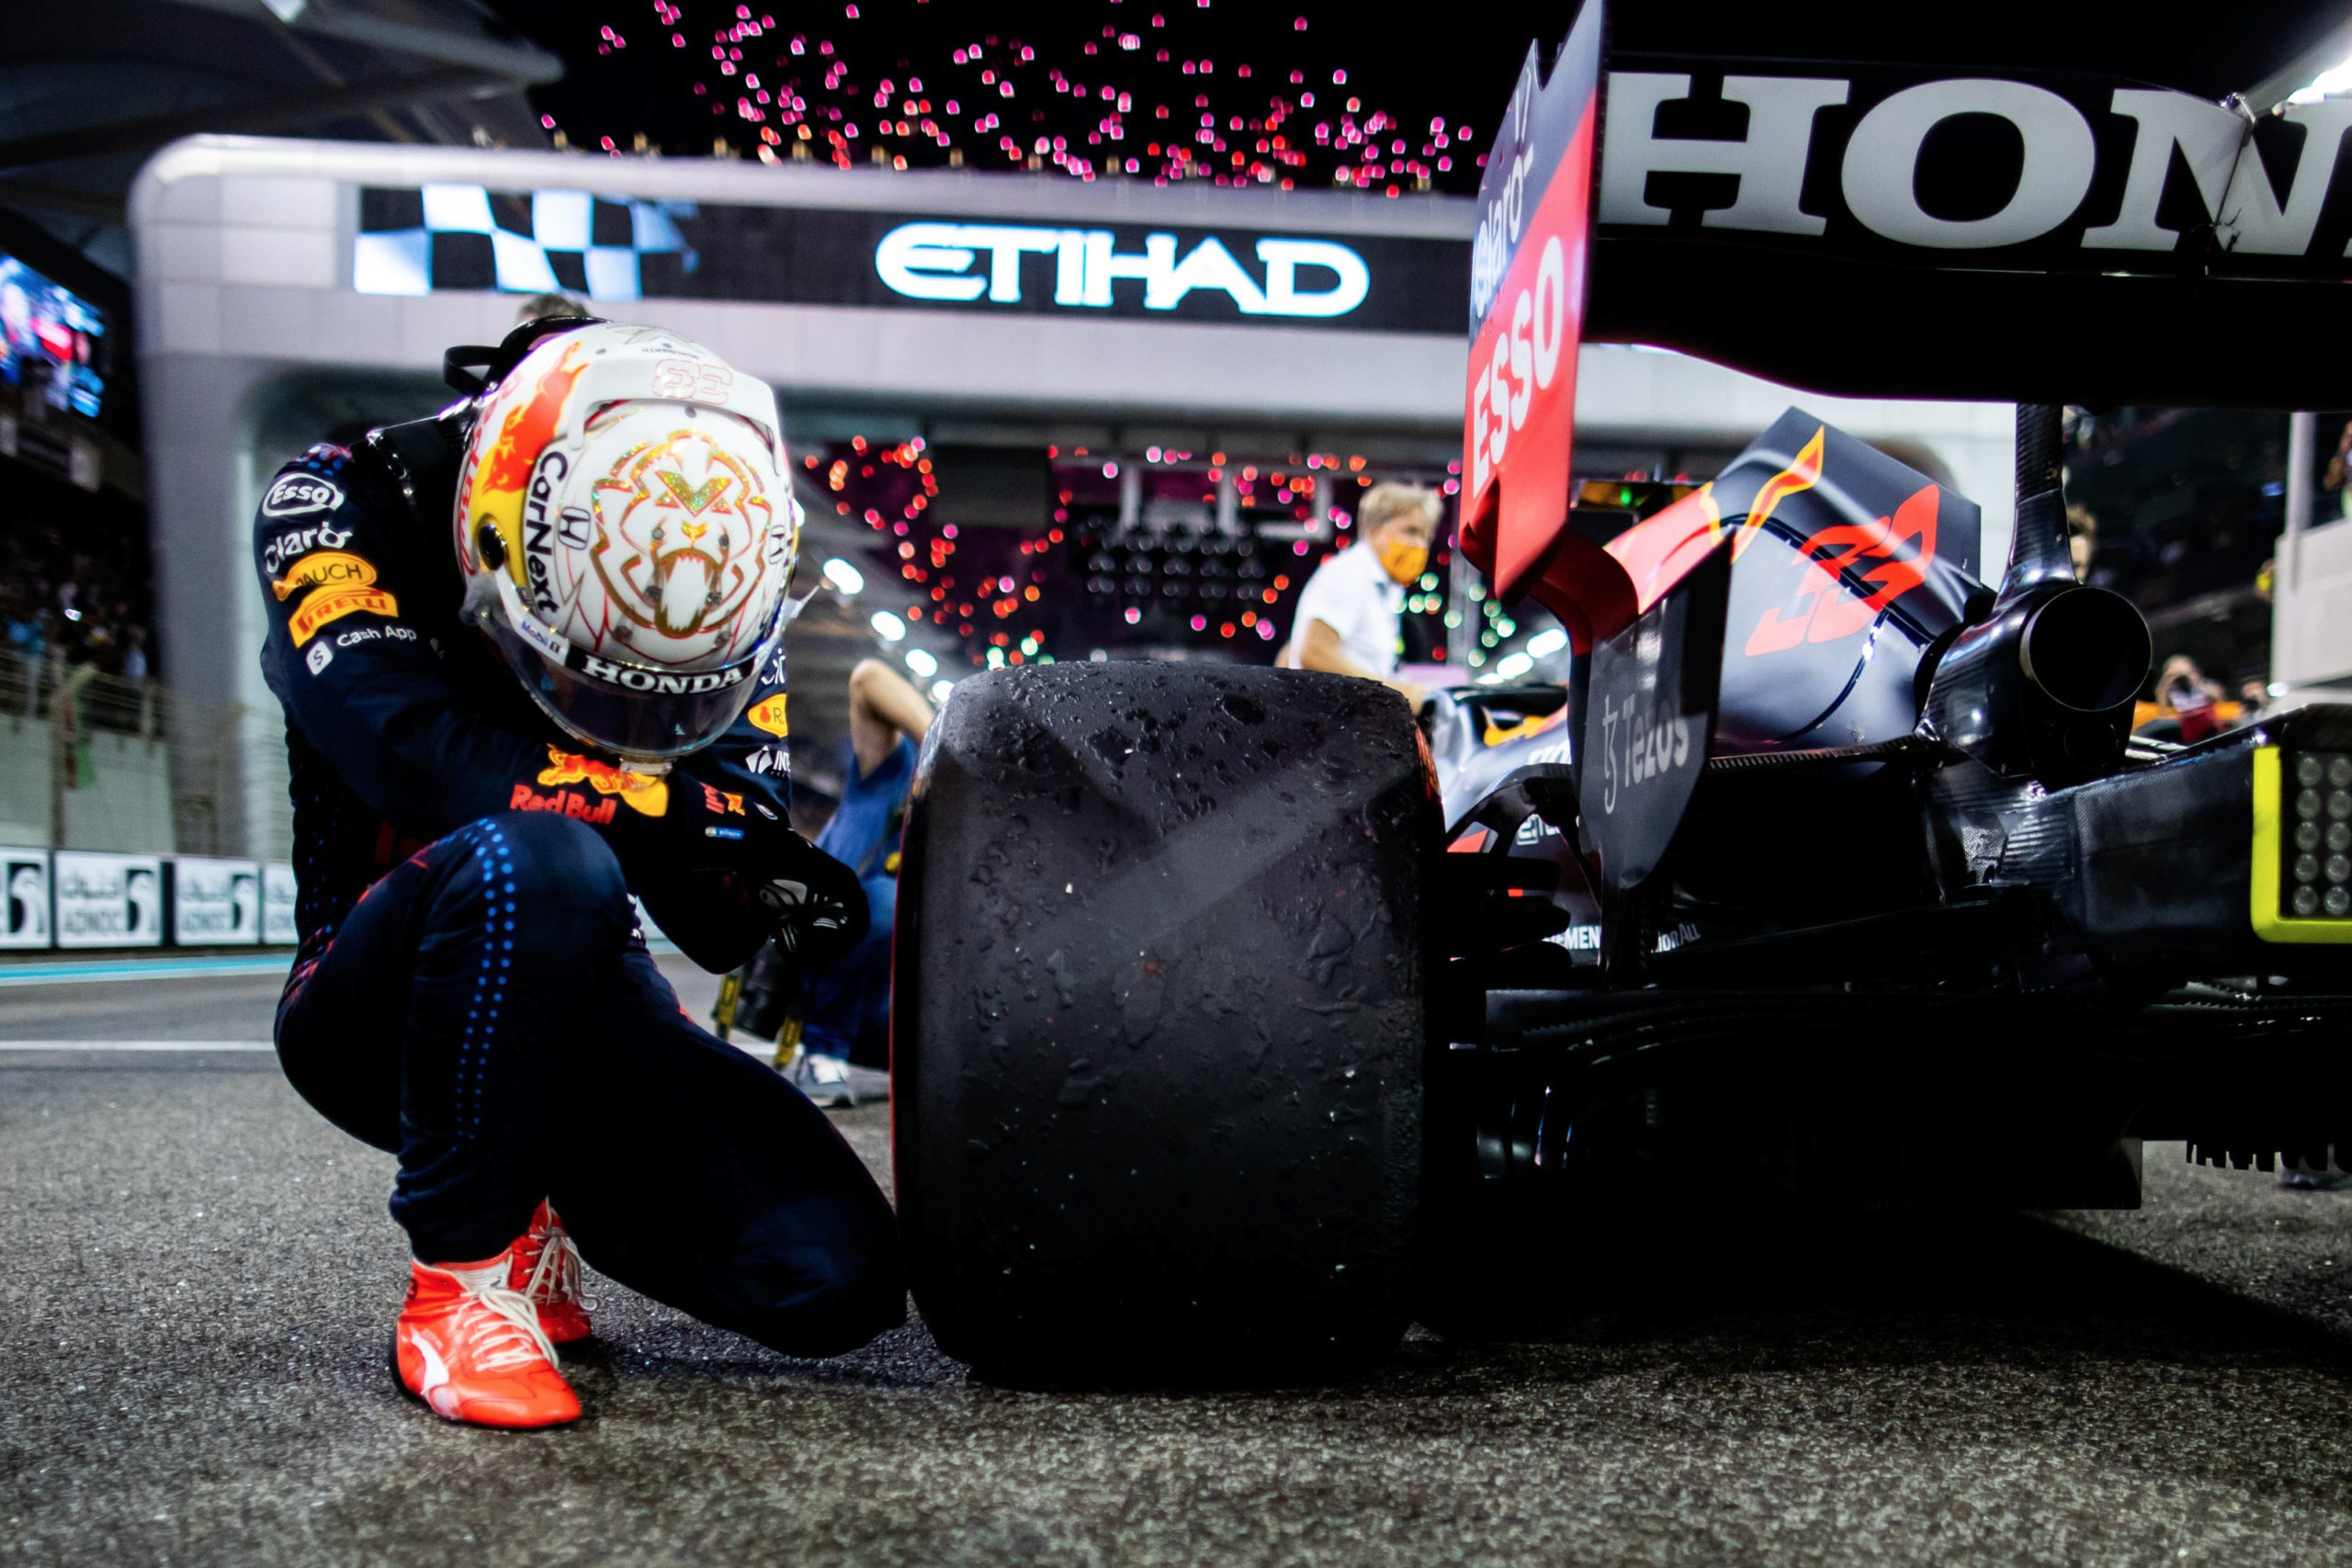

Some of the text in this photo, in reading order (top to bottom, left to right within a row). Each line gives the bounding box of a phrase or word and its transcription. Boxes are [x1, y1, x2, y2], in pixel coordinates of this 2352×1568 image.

[1598, 72, 2352, 257] HON
[875, 221, 1370, 317] ETIHAD
[526, 451, 568, 614] CarNext
[336, 627, 381, 647] Cash
[385, 626, 417, 641] App
[582, 654, 744, 695] HONDA
[1623, 694, 1690, 788] Tezos
[509, 784, 617, 826] Red Bull
